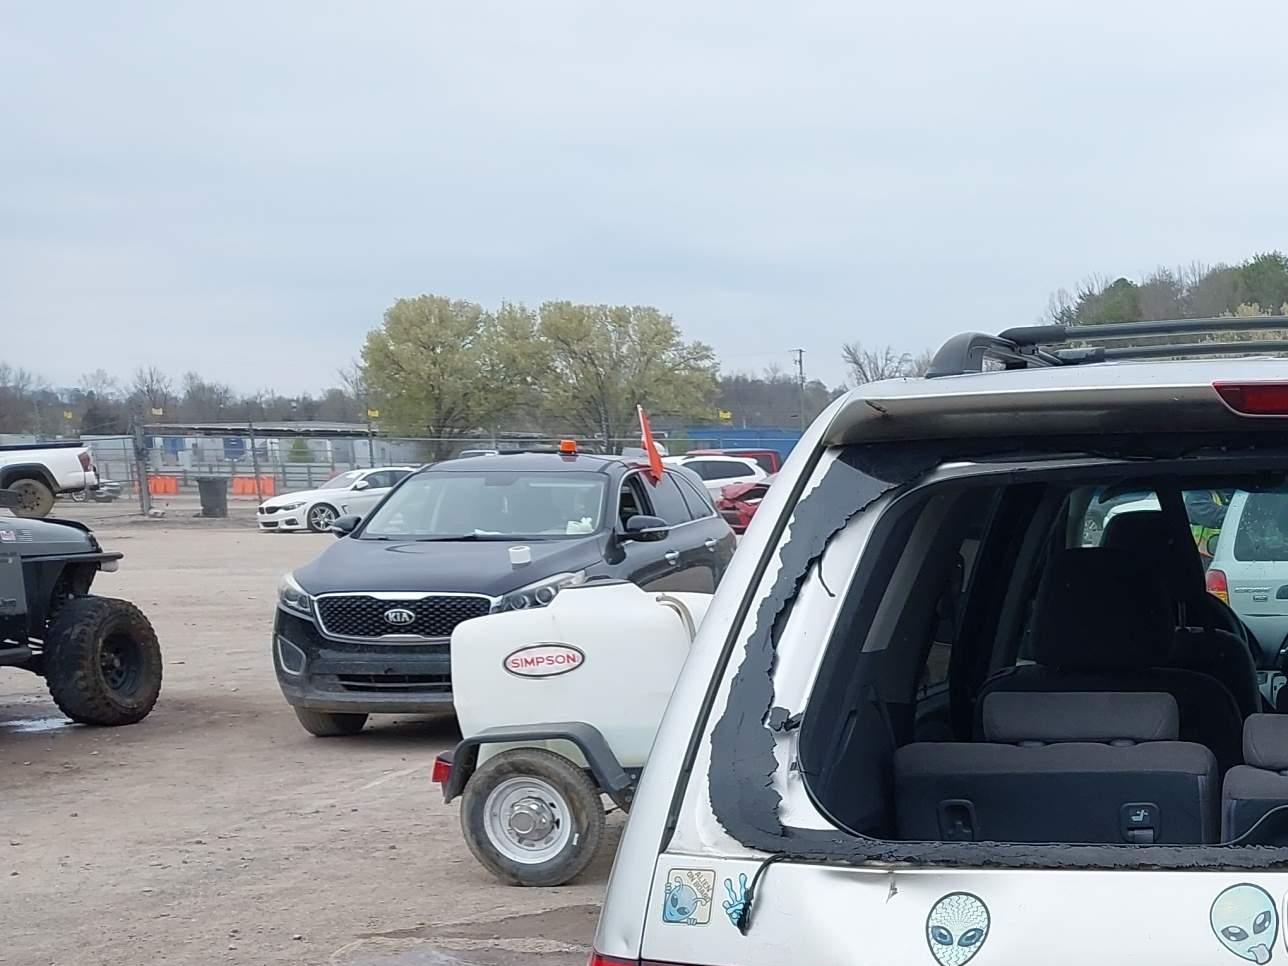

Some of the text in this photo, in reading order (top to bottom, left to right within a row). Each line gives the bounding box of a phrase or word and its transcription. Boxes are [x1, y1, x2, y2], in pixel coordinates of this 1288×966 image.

[387, 611, 411, 623] KIA
[511, 653, 577, 669] SIMPSON
[686, 871, 697, 882] ON
[695, 871, 712, 892] ALIEN
